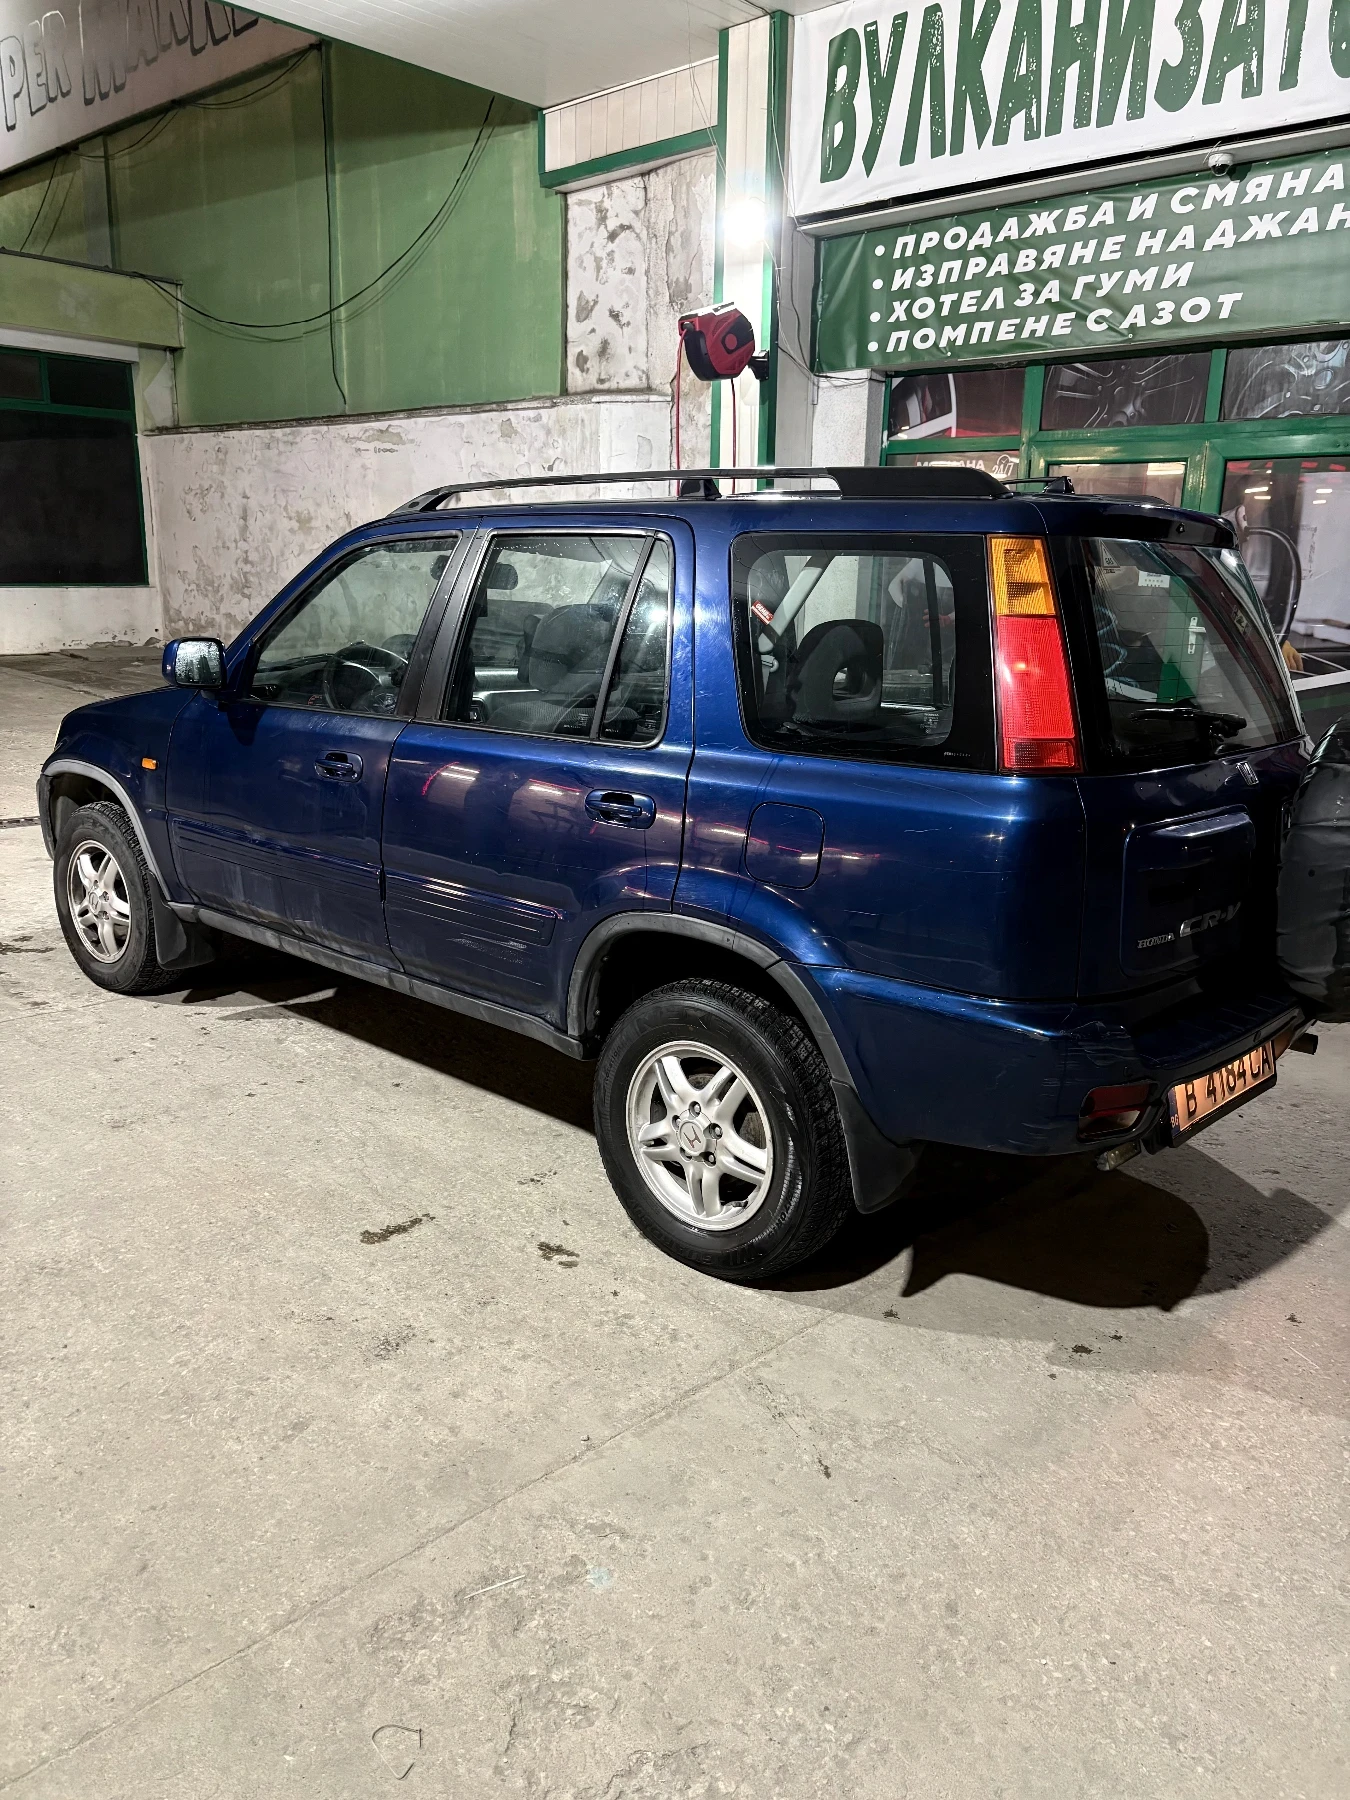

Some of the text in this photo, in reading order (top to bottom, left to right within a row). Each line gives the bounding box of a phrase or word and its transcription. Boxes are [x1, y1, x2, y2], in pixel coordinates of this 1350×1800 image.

[892, 163, 1345, 259] ПРОДАЖБА И СМЯНА
[891, 234, 1126, 292] ИЗПРАВЯНЕ
[1135, 224, 1195, 257] НА
[886, 292, 1243, 353] ПОМПЕНЕ С АЗОТ
[887, 262, 1194, 323] ХОТЕЛ ЗА ГУМИ
[1137, 900, 1242, 949] HONDA CR-V
[1185, 1082, 1198, 1119] B
